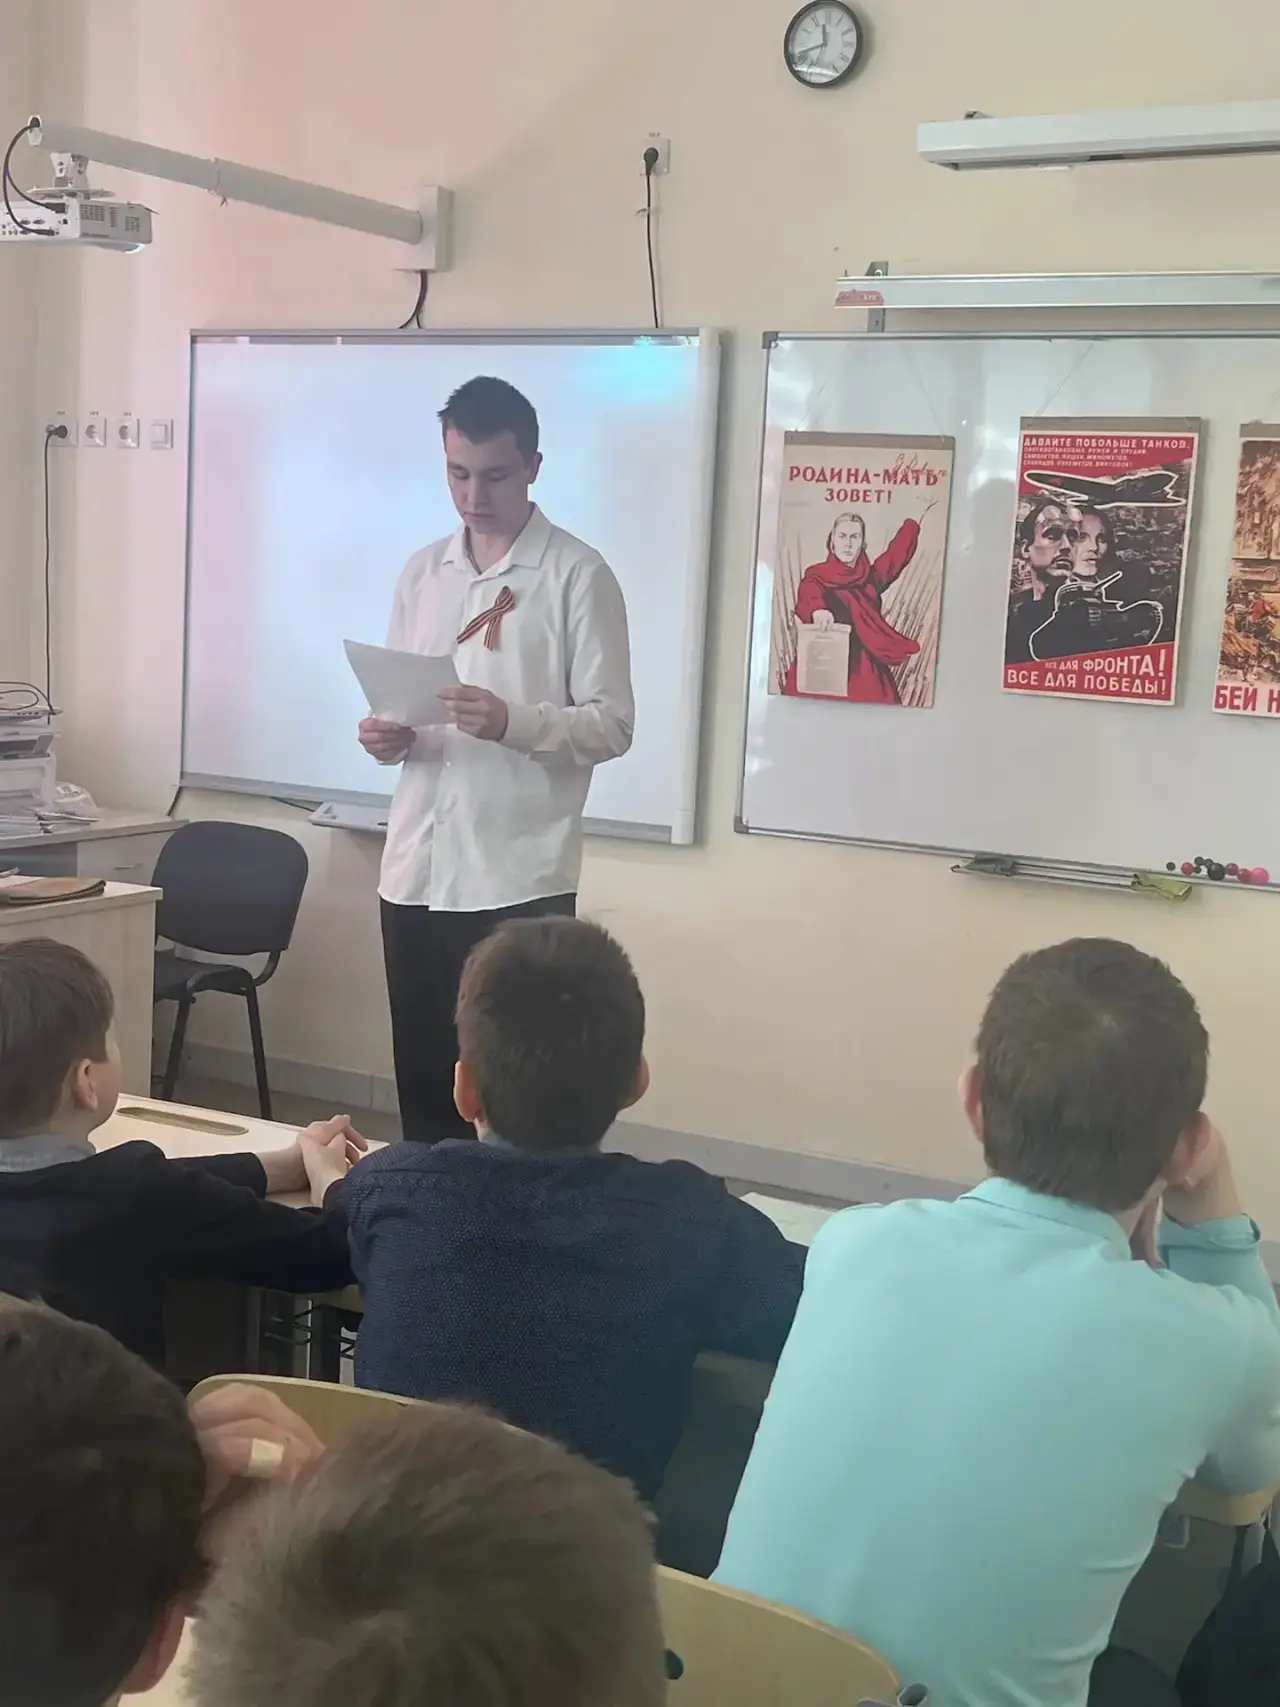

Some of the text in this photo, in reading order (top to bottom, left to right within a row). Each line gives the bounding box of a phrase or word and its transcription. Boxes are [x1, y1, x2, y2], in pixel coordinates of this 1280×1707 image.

[1076, 438, 1137, 448] ПОБОЛЬШЕ
[789, 466, 938, 486] РОДИНА-МАТЬ
[825, 488, 892, 504] ЗОВЕТ!
[1059, 660, 1079, 670] ДЛЯ
[1083, 649, 1165, 676] ФРОНТА!
[1007, 670, 1166, 695] ВСЕ ДЛЯ ПОБЕДЫ!
